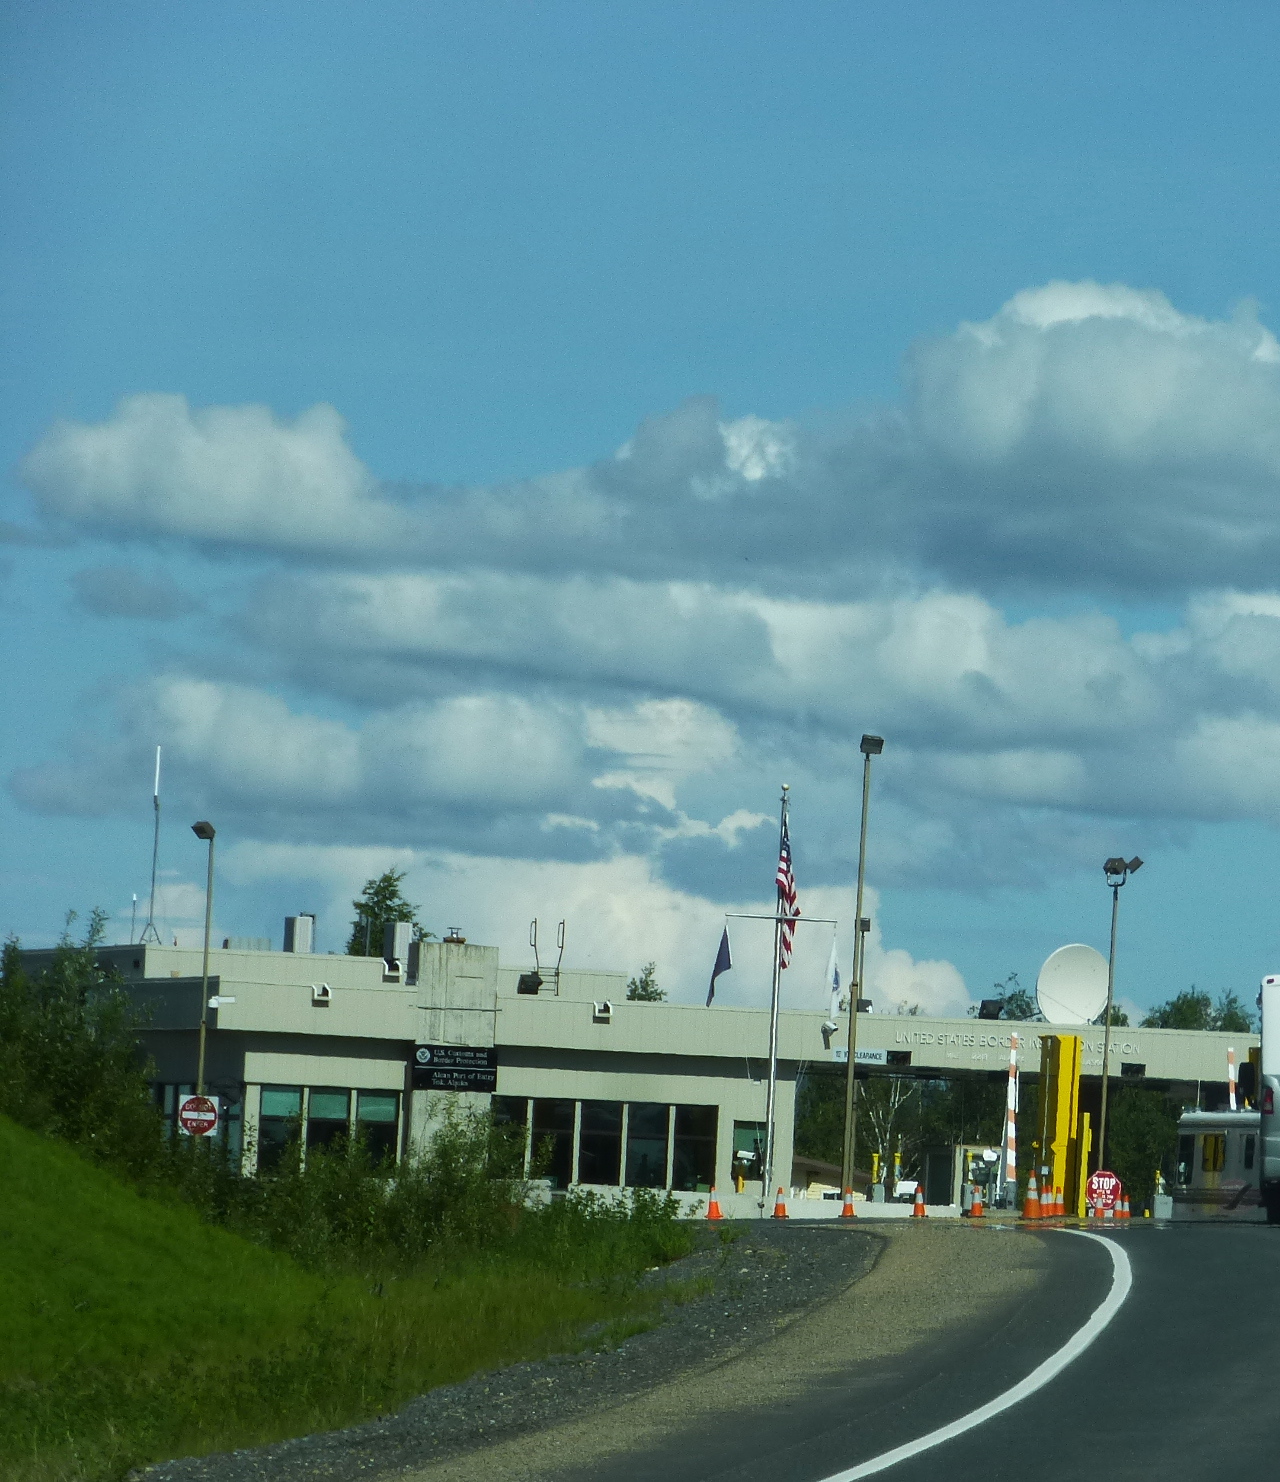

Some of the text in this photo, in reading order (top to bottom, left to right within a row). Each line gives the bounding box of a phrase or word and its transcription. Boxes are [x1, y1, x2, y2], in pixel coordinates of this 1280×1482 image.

[895, 1031, 935, 1045] UNITED
[937, 1034, 975, 1047] STATES
[979, 1036, 1025, 1050] BORDR
[433, 1056, 488, 1065] Border Protection
[452, 1072, 466, 1080] Port
[477, 1073, 495, 1081] Entry
[1092, 1177, 1116, 1190] STOP
